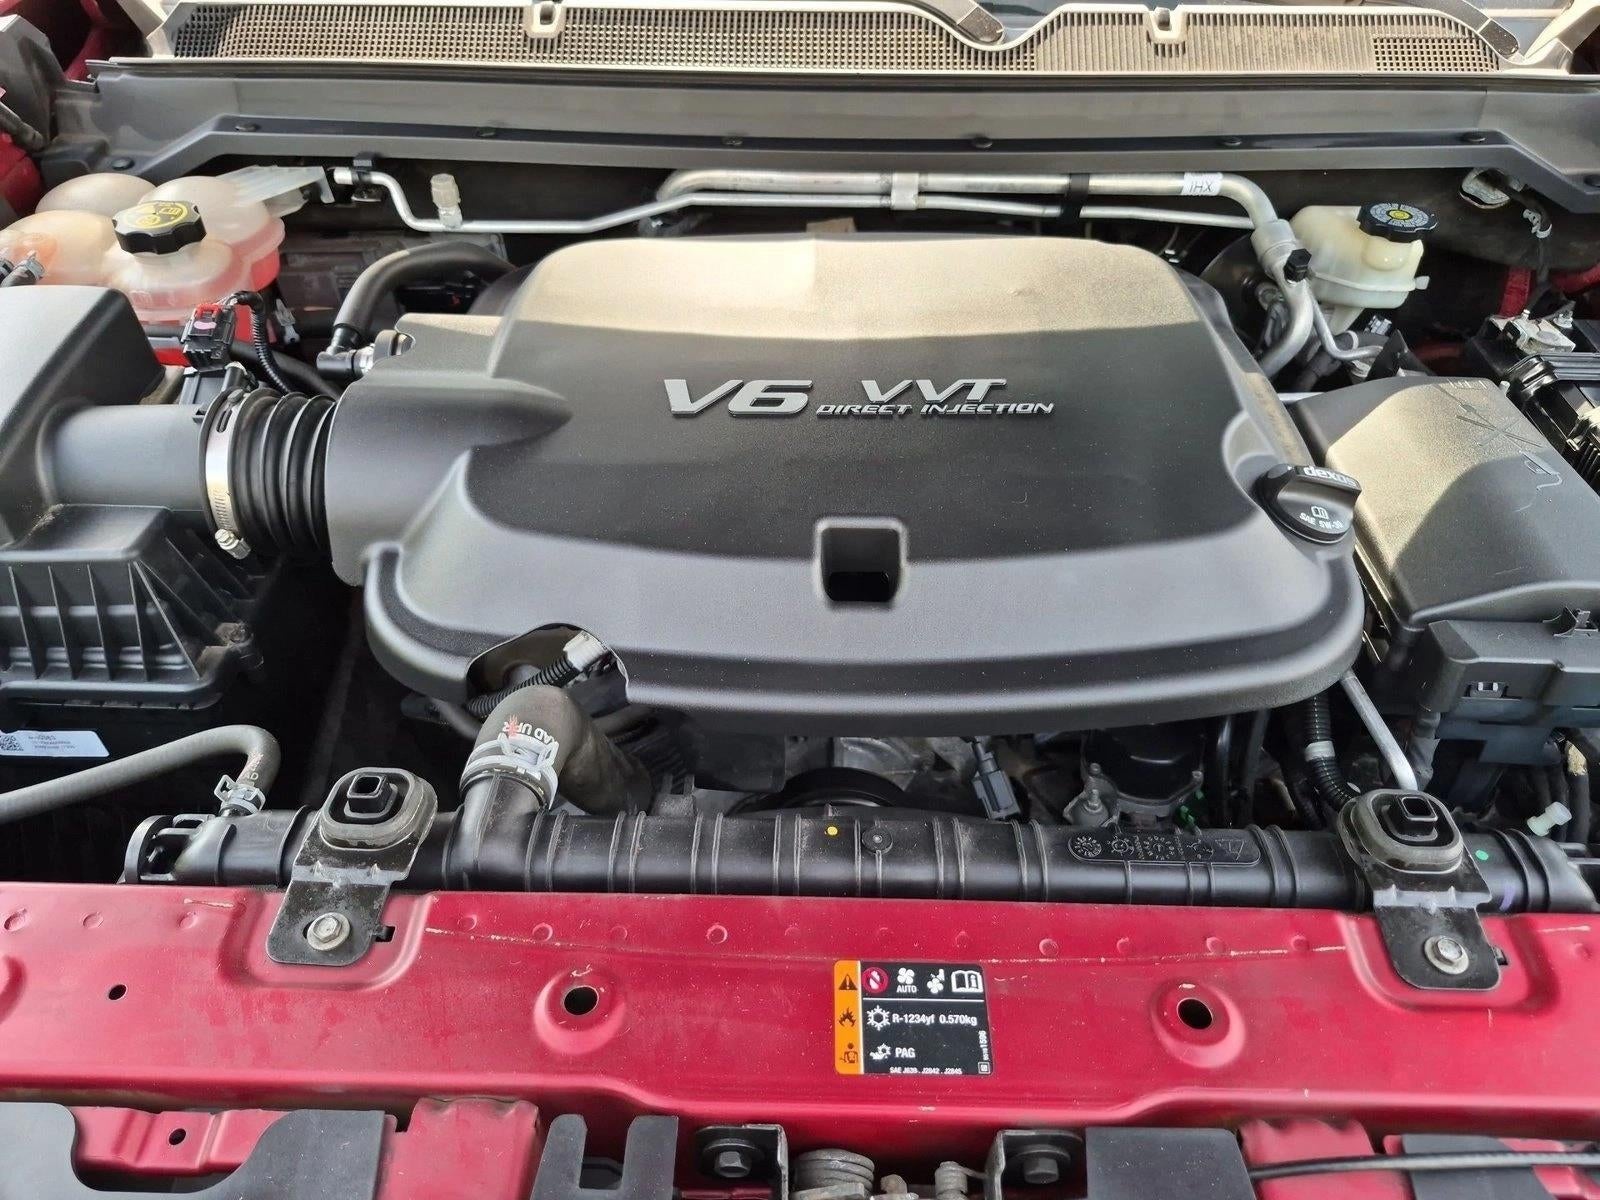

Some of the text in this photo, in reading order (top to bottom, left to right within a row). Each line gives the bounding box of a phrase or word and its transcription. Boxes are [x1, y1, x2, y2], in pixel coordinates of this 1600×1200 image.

[860, 378, 1008, 403] VVT
[663, 379, 813, 417] V6
[815, 402, 1055, 417] DIRECT INJECTION
[896, 985, 917, 993] AUTO
[892, 1013, 978, 1026] R-1234yf 0.570kg
[895, 1047, 916, 1058] PAG
[889, 1066, 902, 1074] SAE
